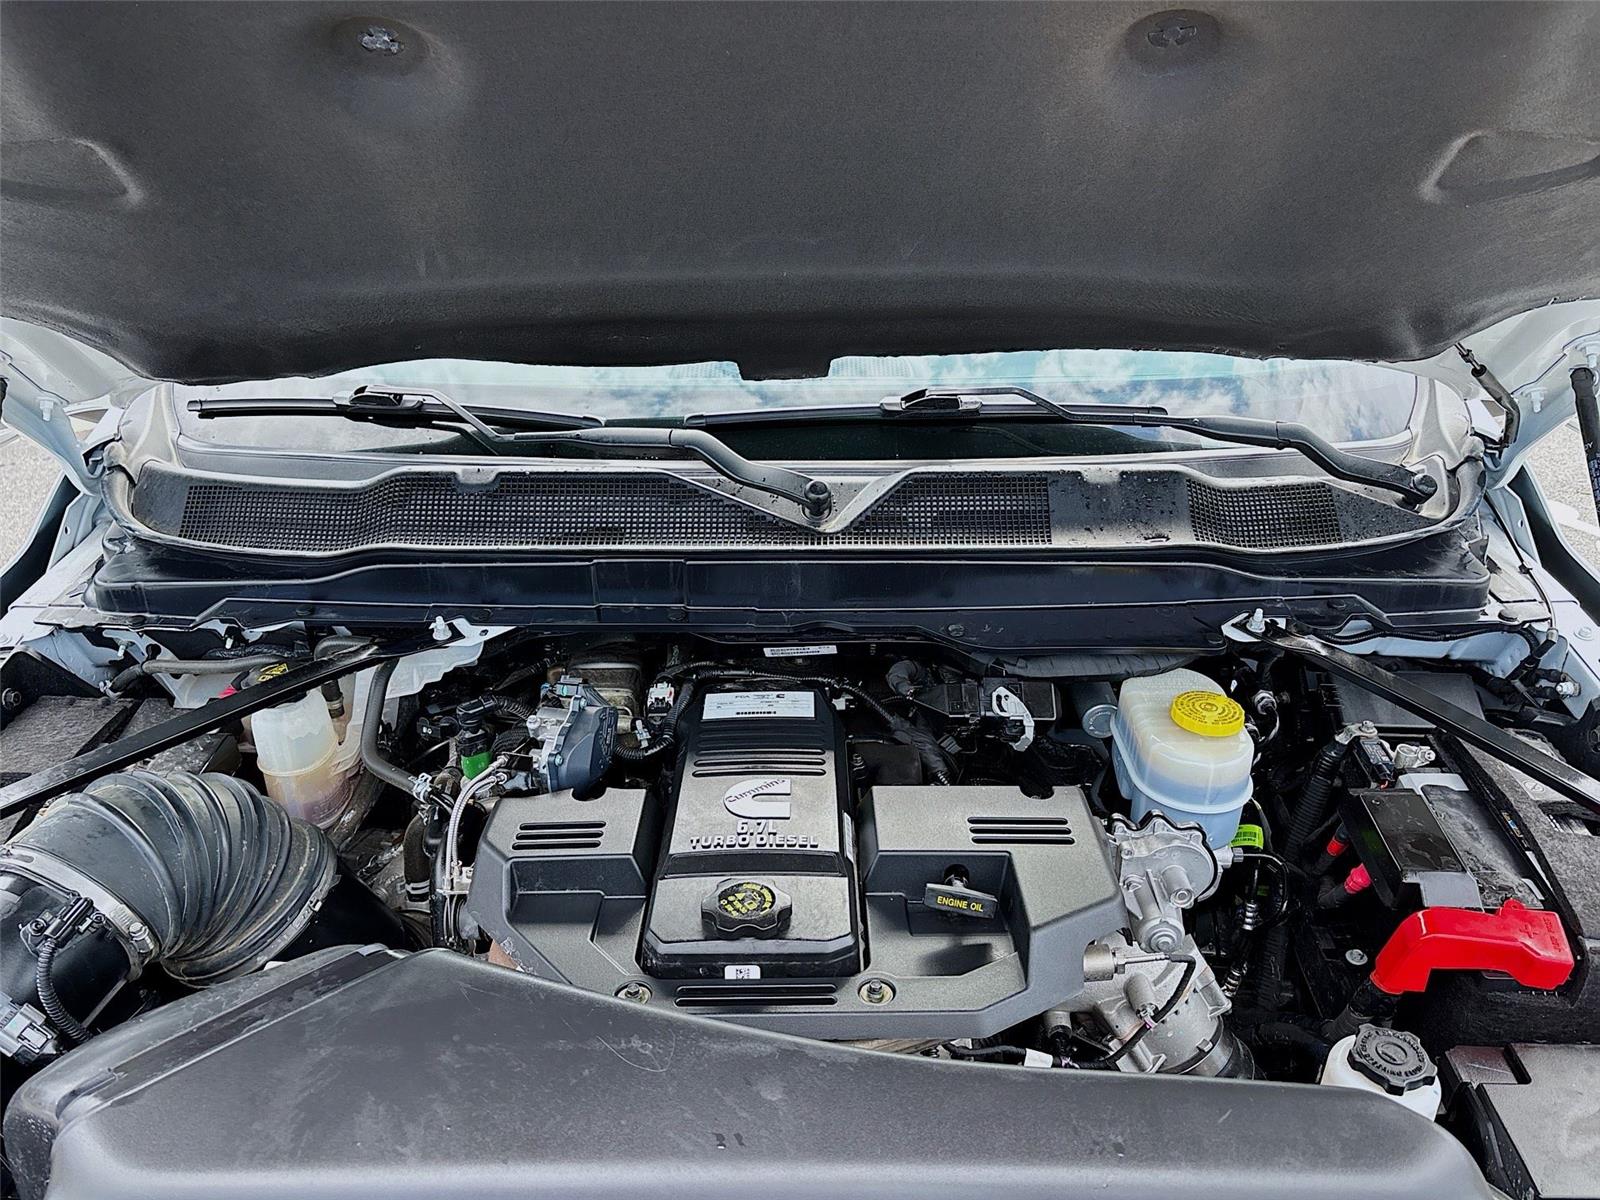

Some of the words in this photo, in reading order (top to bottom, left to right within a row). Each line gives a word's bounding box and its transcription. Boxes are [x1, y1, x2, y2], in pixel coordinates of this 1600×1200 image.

[736, 820, 777, 836] 6.7L
[690, 834, 750, 849] TURBO
[755, 834, 819, 848] DIESEL
[937, 895, 968, 909] ENGINE
[970, 902, 984, 912] OIL
